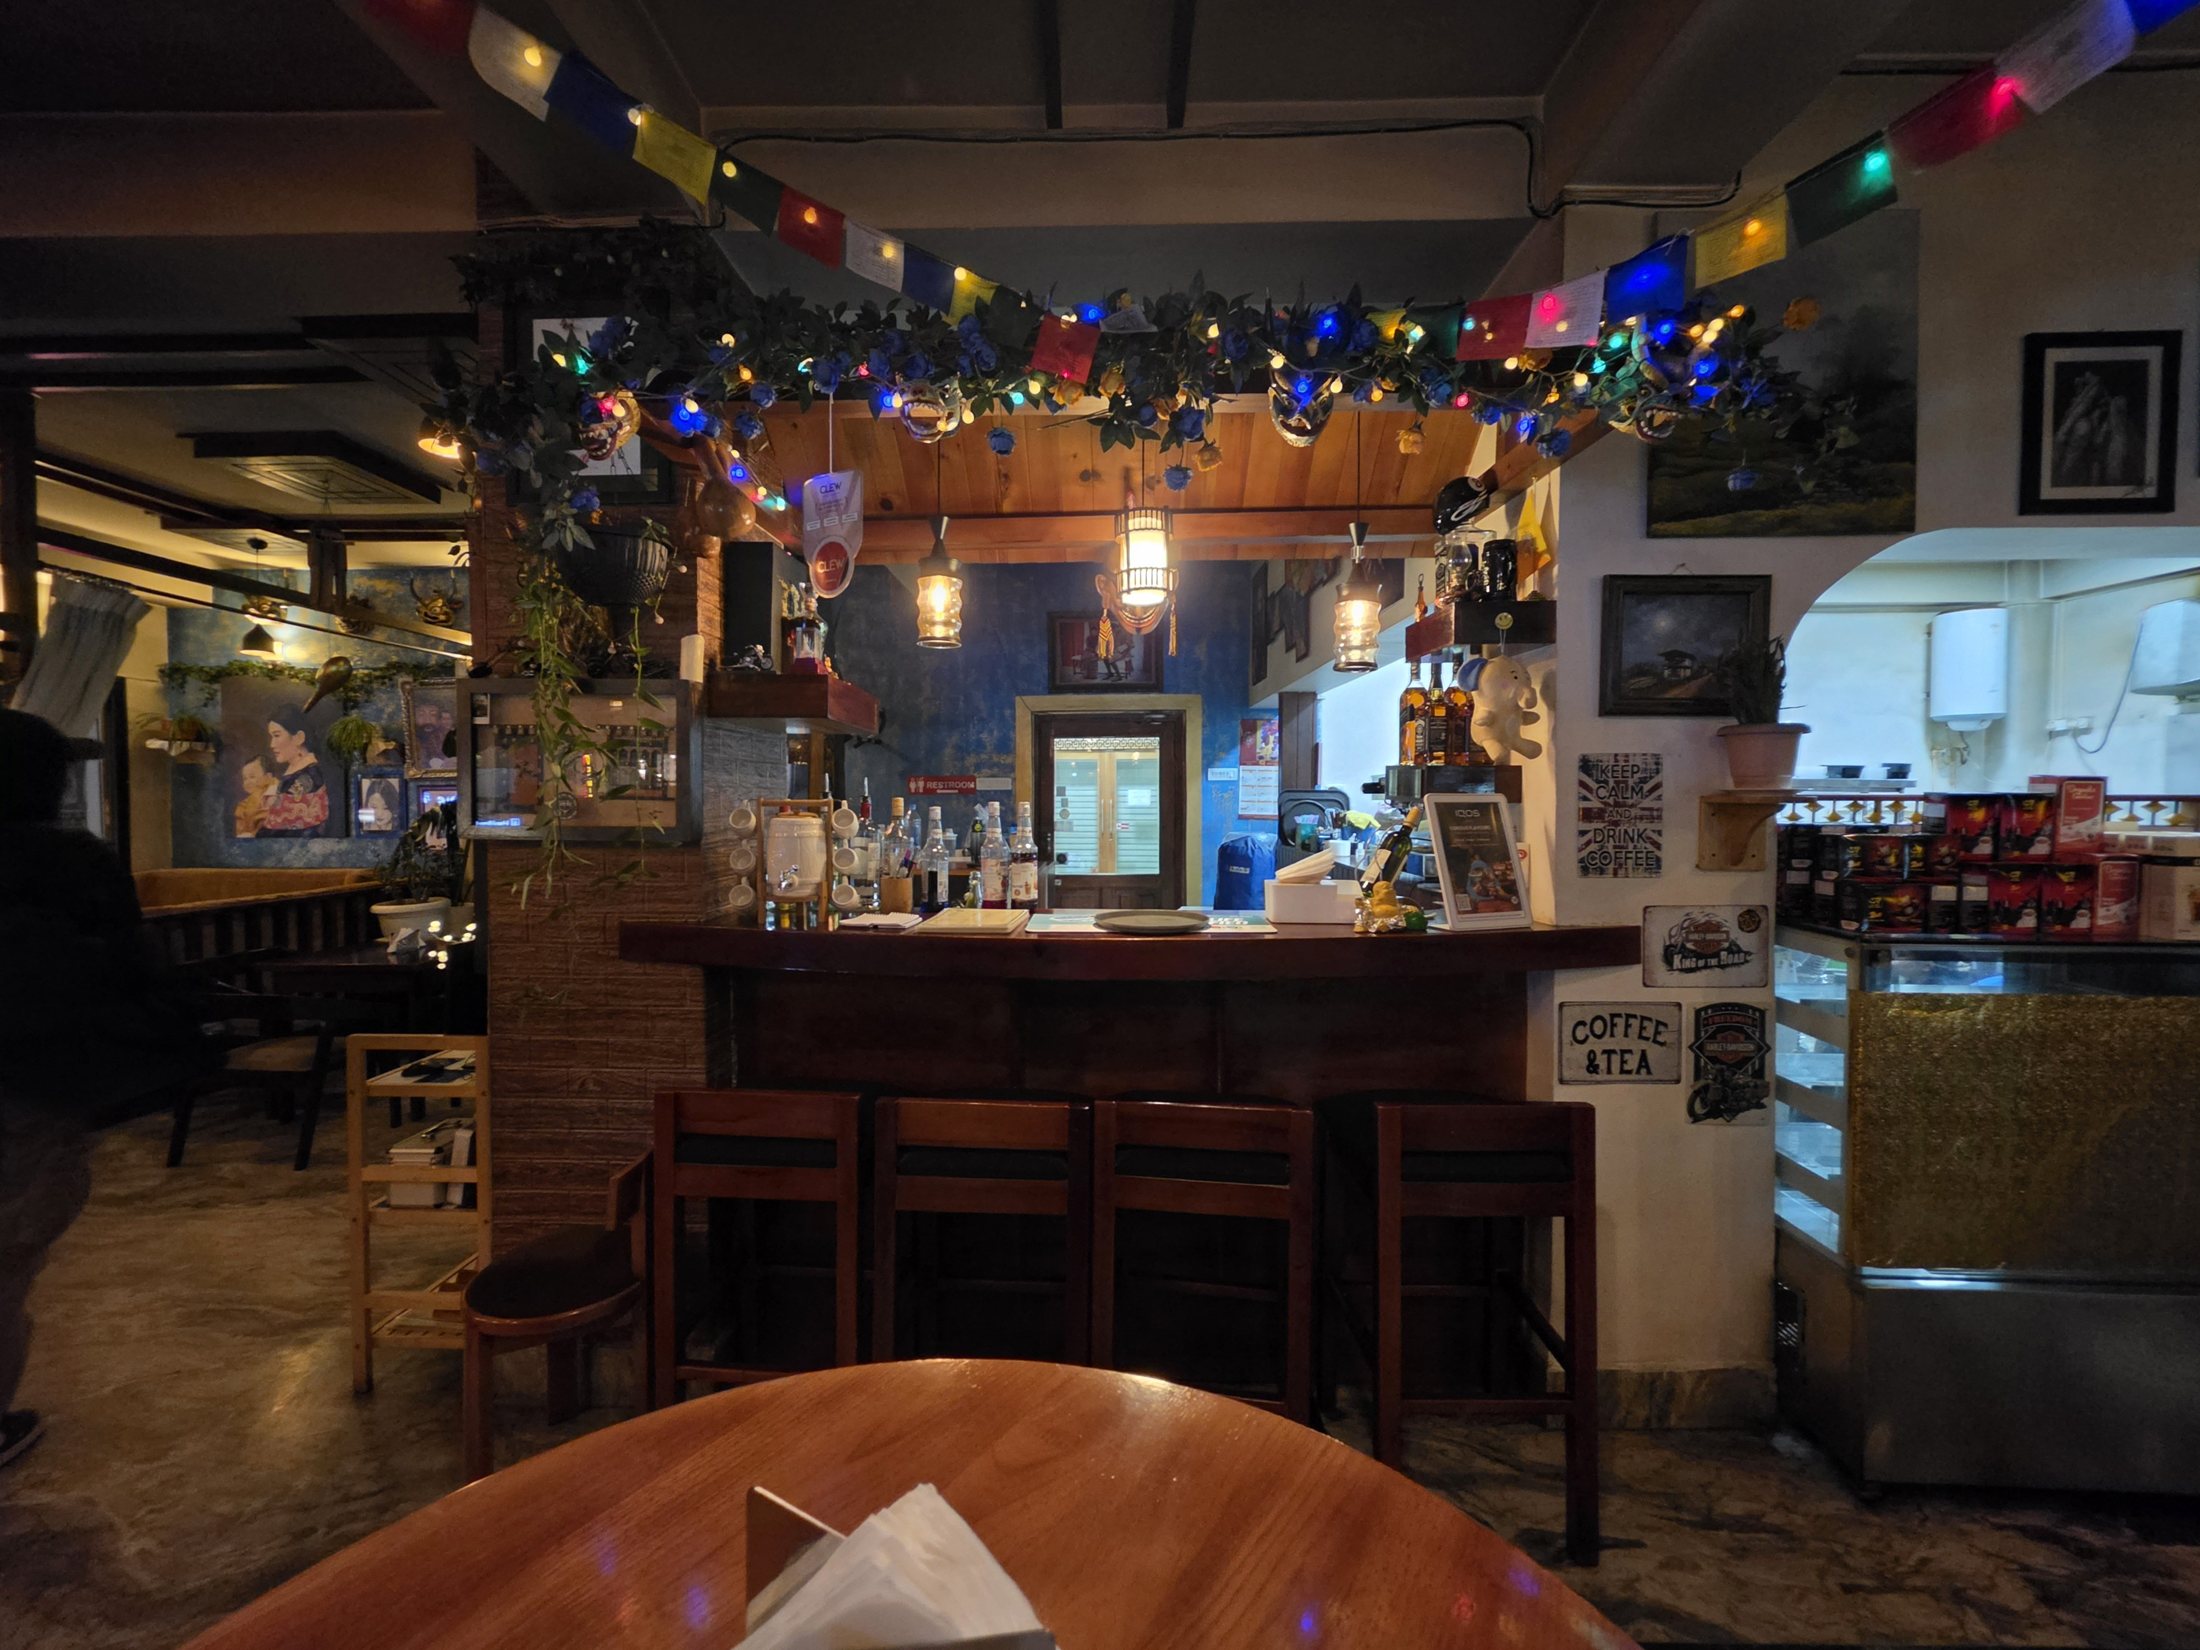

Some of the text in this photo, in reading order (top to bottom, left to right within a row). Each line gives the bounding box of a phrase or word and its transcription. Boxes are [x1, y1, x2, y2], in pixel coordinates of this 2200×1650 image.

[819, 481, 842, 495] CLEW
[817, 558, 845, 574] CLEW
[1599, 764, 1640, 779] KEEP
[926, 781, 975, 789] RESTROOM
[1595, 784, 1645, 800] CALM
[1455, 809, 1480, 818] IQOS
[1607, 809, 1632, 819] AND
[1593, 828, 1649, 844] DRINK
[1586, 850, 1656, 867] COFFEE
[1572, 1012, 1669, 1046] COFFEE
